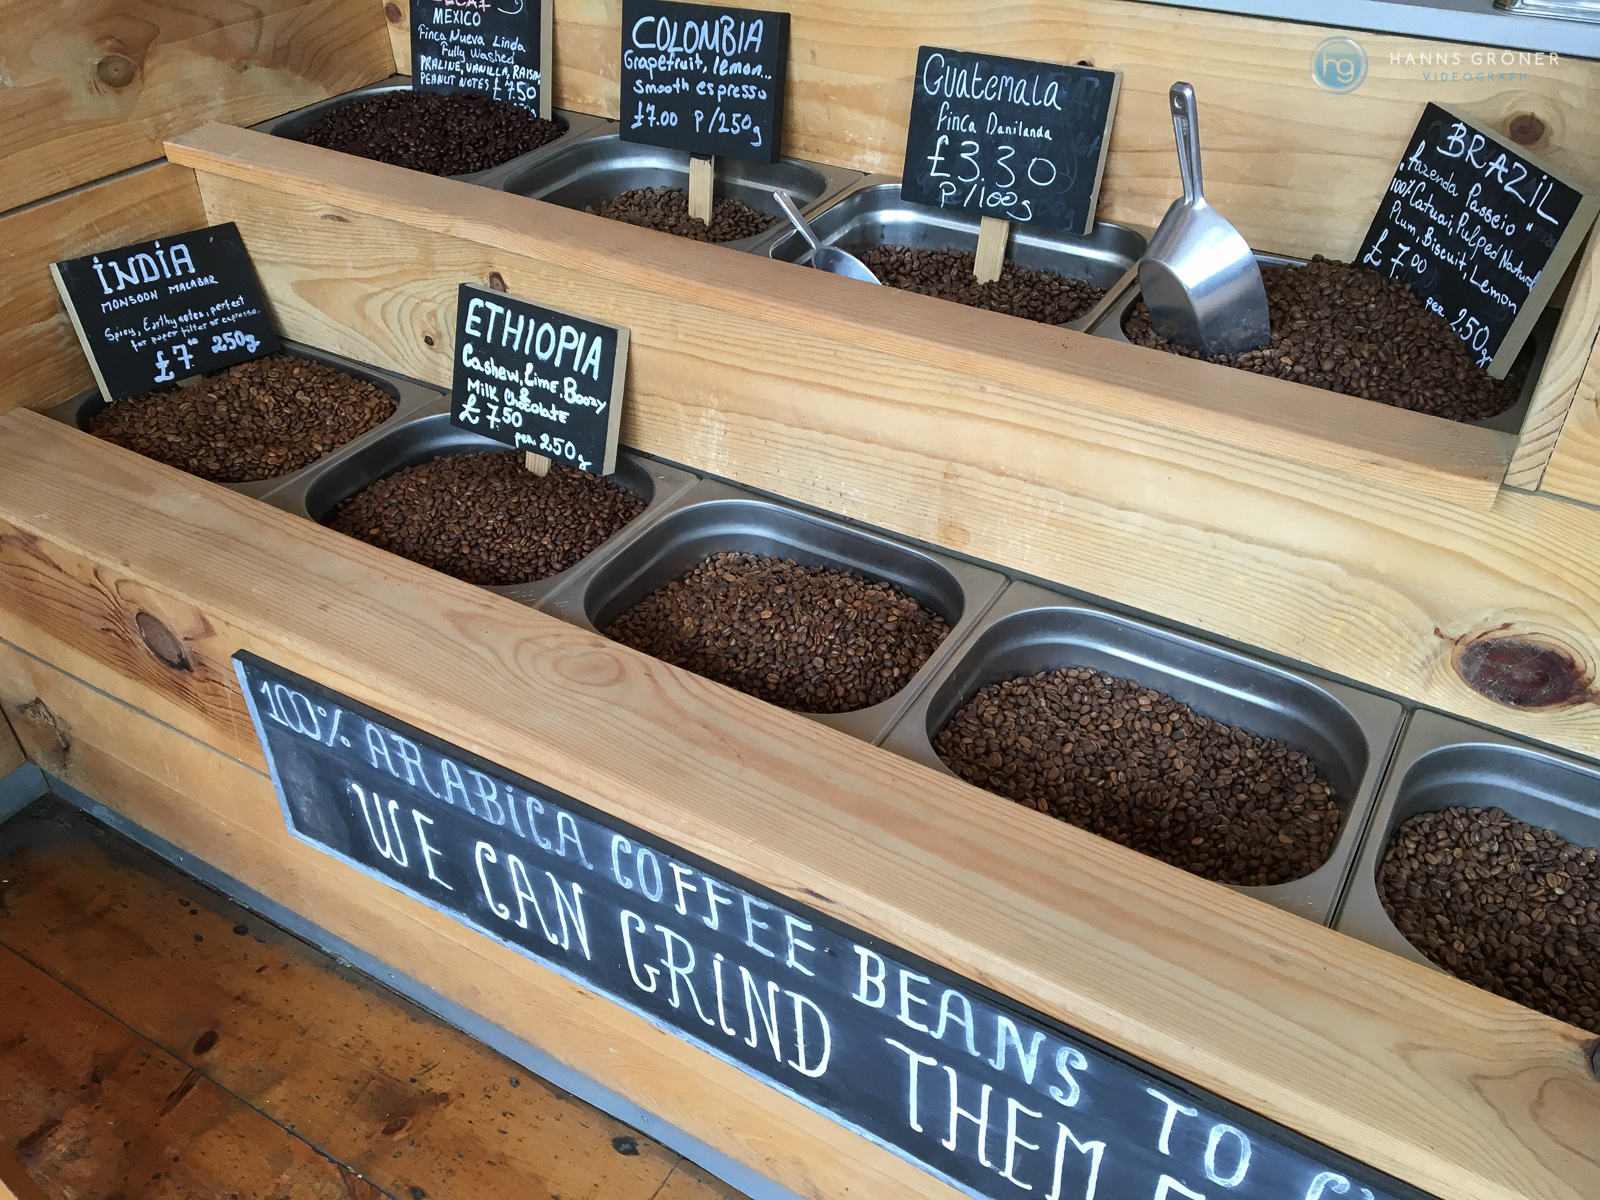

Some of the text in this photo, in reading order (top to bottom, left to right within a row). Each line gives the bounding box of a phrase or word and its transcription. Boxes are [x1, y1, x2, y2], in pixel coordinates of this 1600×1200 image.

[432, 7, 481, 27] MEXICO
[418, 24, 526, 52] Finca Nueva Linda
[631, 15, 764, 56] COLOMBIA
[420, 55, 464, 75] PRALINE,
[465, 62, 510, 80] VANILLA,
[440, 41, 515, 66] Fully Washed
[623, 49, 708, 80] Grapefruit,
[420, 72, 490, 91] PEANUT NOTES
[695, 80, 767, 103] espresso
[986, 112, 1053, 141] Danilanda
[1390, 177, 1416, 198] 100%
[1456, 211, 1504, 260] Pulped
[101, 274, 219, 314] MONSOON MALABAR
[1469, 264, 1518, 315] Lemon
[104, 326, 142, 343] Spicy,
[210, 294, 245, 317] perfect
[130, 339, 147, 353] for
[151, 329, 178, 345] paper
[180, 321, 208, 338] filter
[209, 317, 219, 327] or
[211, 330, 260, 354] 250g
[465, 297, 602, 381] ETHIOPIA
[462, 342, 523, 386] Cashew,
[563, 376, 607, 415] Boozy
[467, 377, 500, 403] Milk
[260, 680, 351, 748] 100%
[611, 834, 816, 977] COFFEE
[852, 944, 1089, 1107] BEANS
[1146, 1087, 1252, 1188] TO
[351, 783, 455, 891] WE
[475, 840, 592, 961] CAN
[884, 1037, 1107, 1200] THEM
